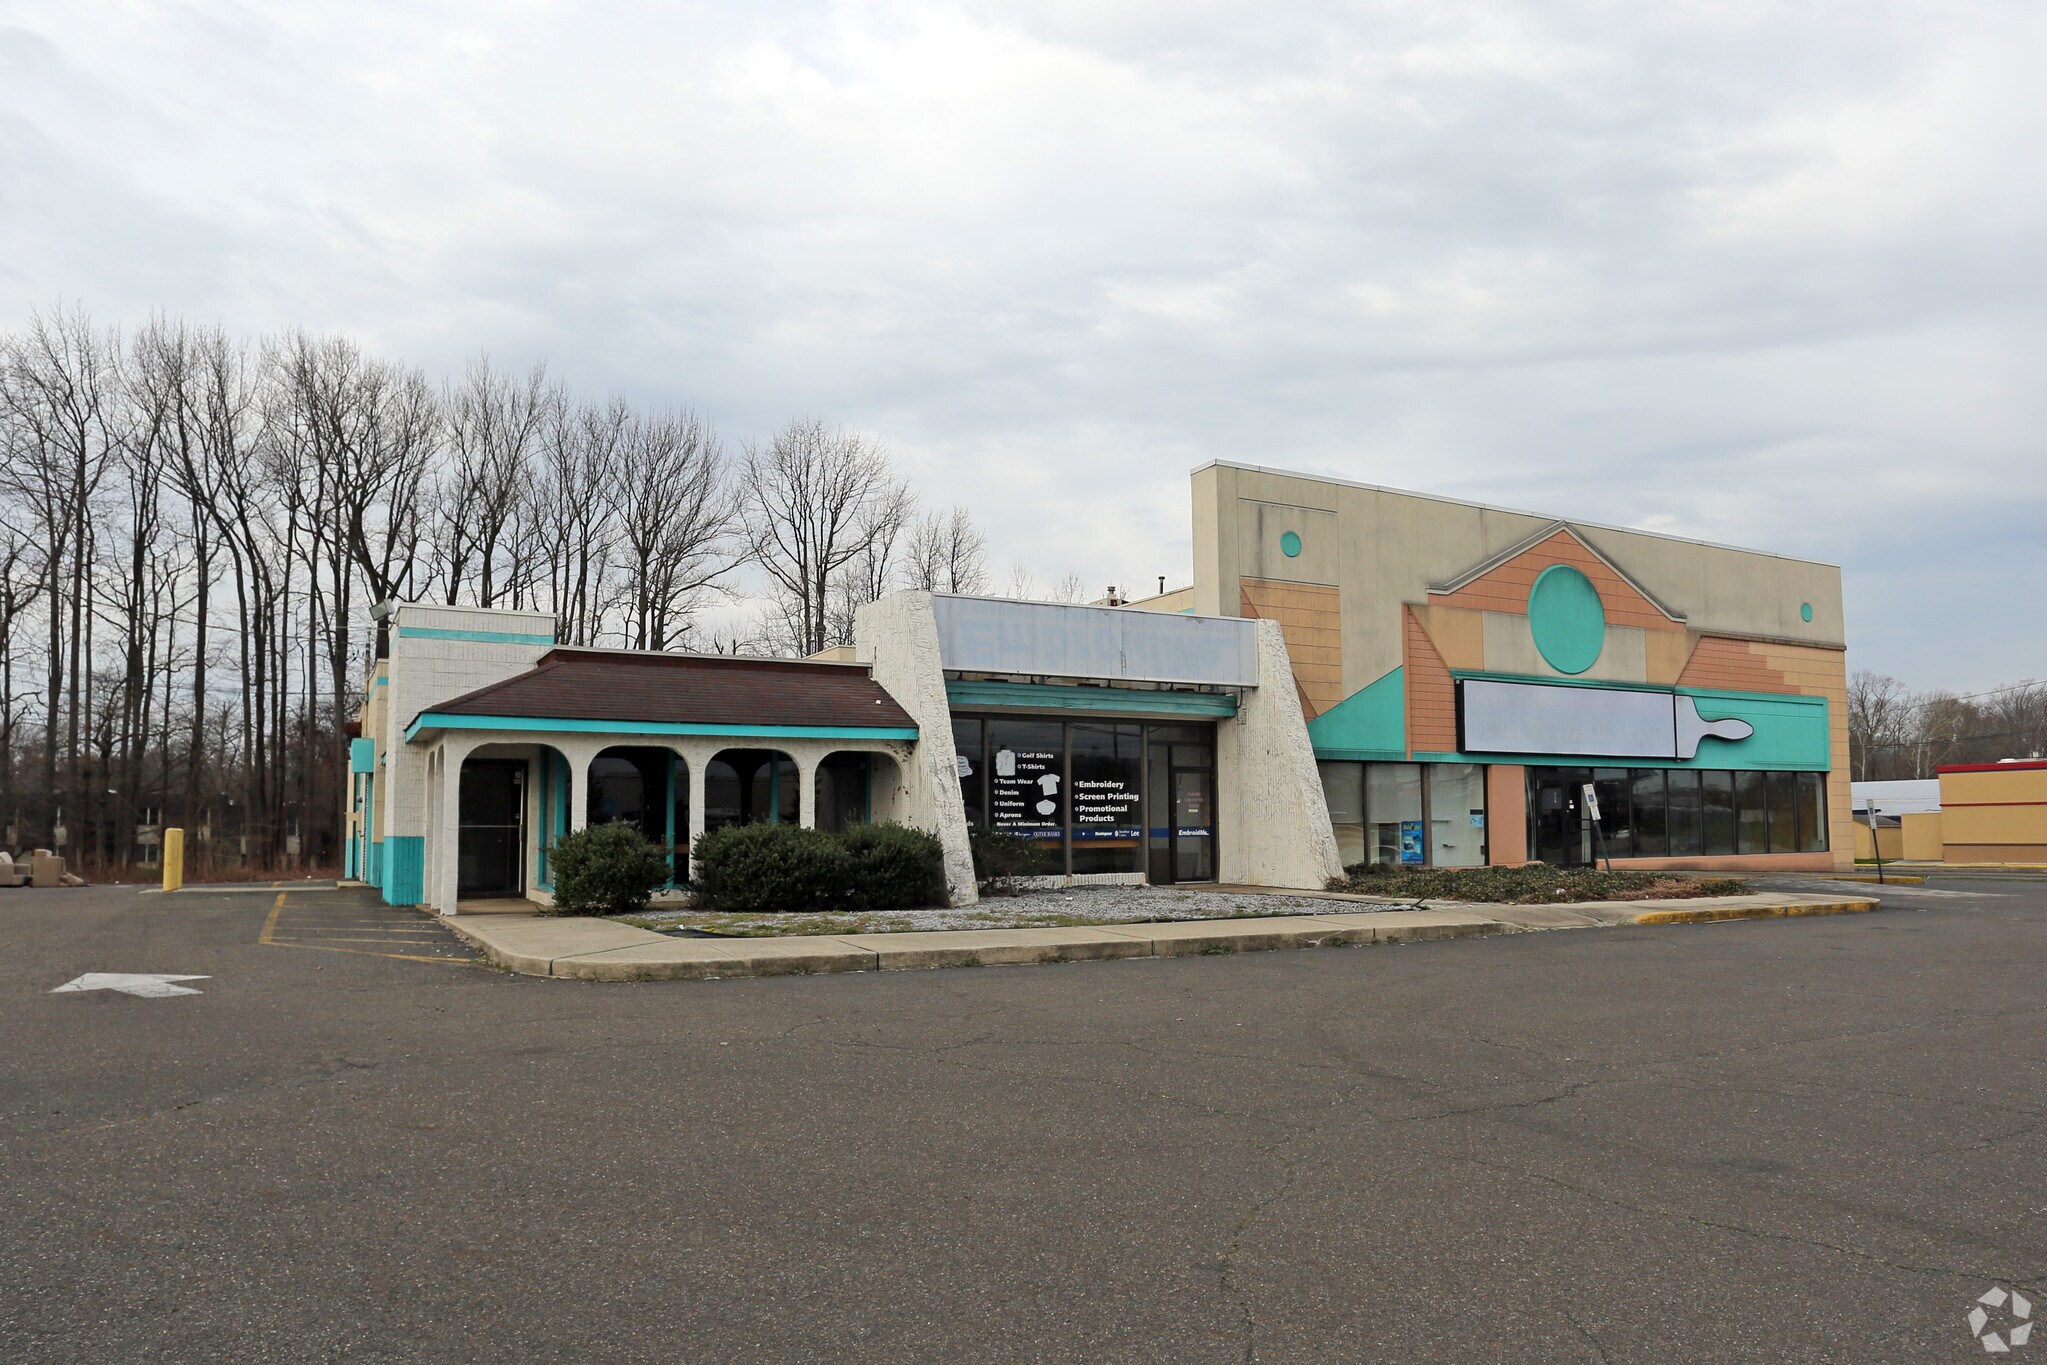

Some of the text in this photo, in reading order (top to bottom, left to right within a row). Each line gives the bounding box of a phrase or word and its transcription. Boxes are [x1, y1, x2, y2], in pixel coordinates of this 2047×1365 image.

[1079, 780, 1124, 790] Embroidery
[1079, 792, 1139, 802] Screen Printing
[1079, 804, 1128, 813] Promotional
[1079, 814, 1115, 822] Products
